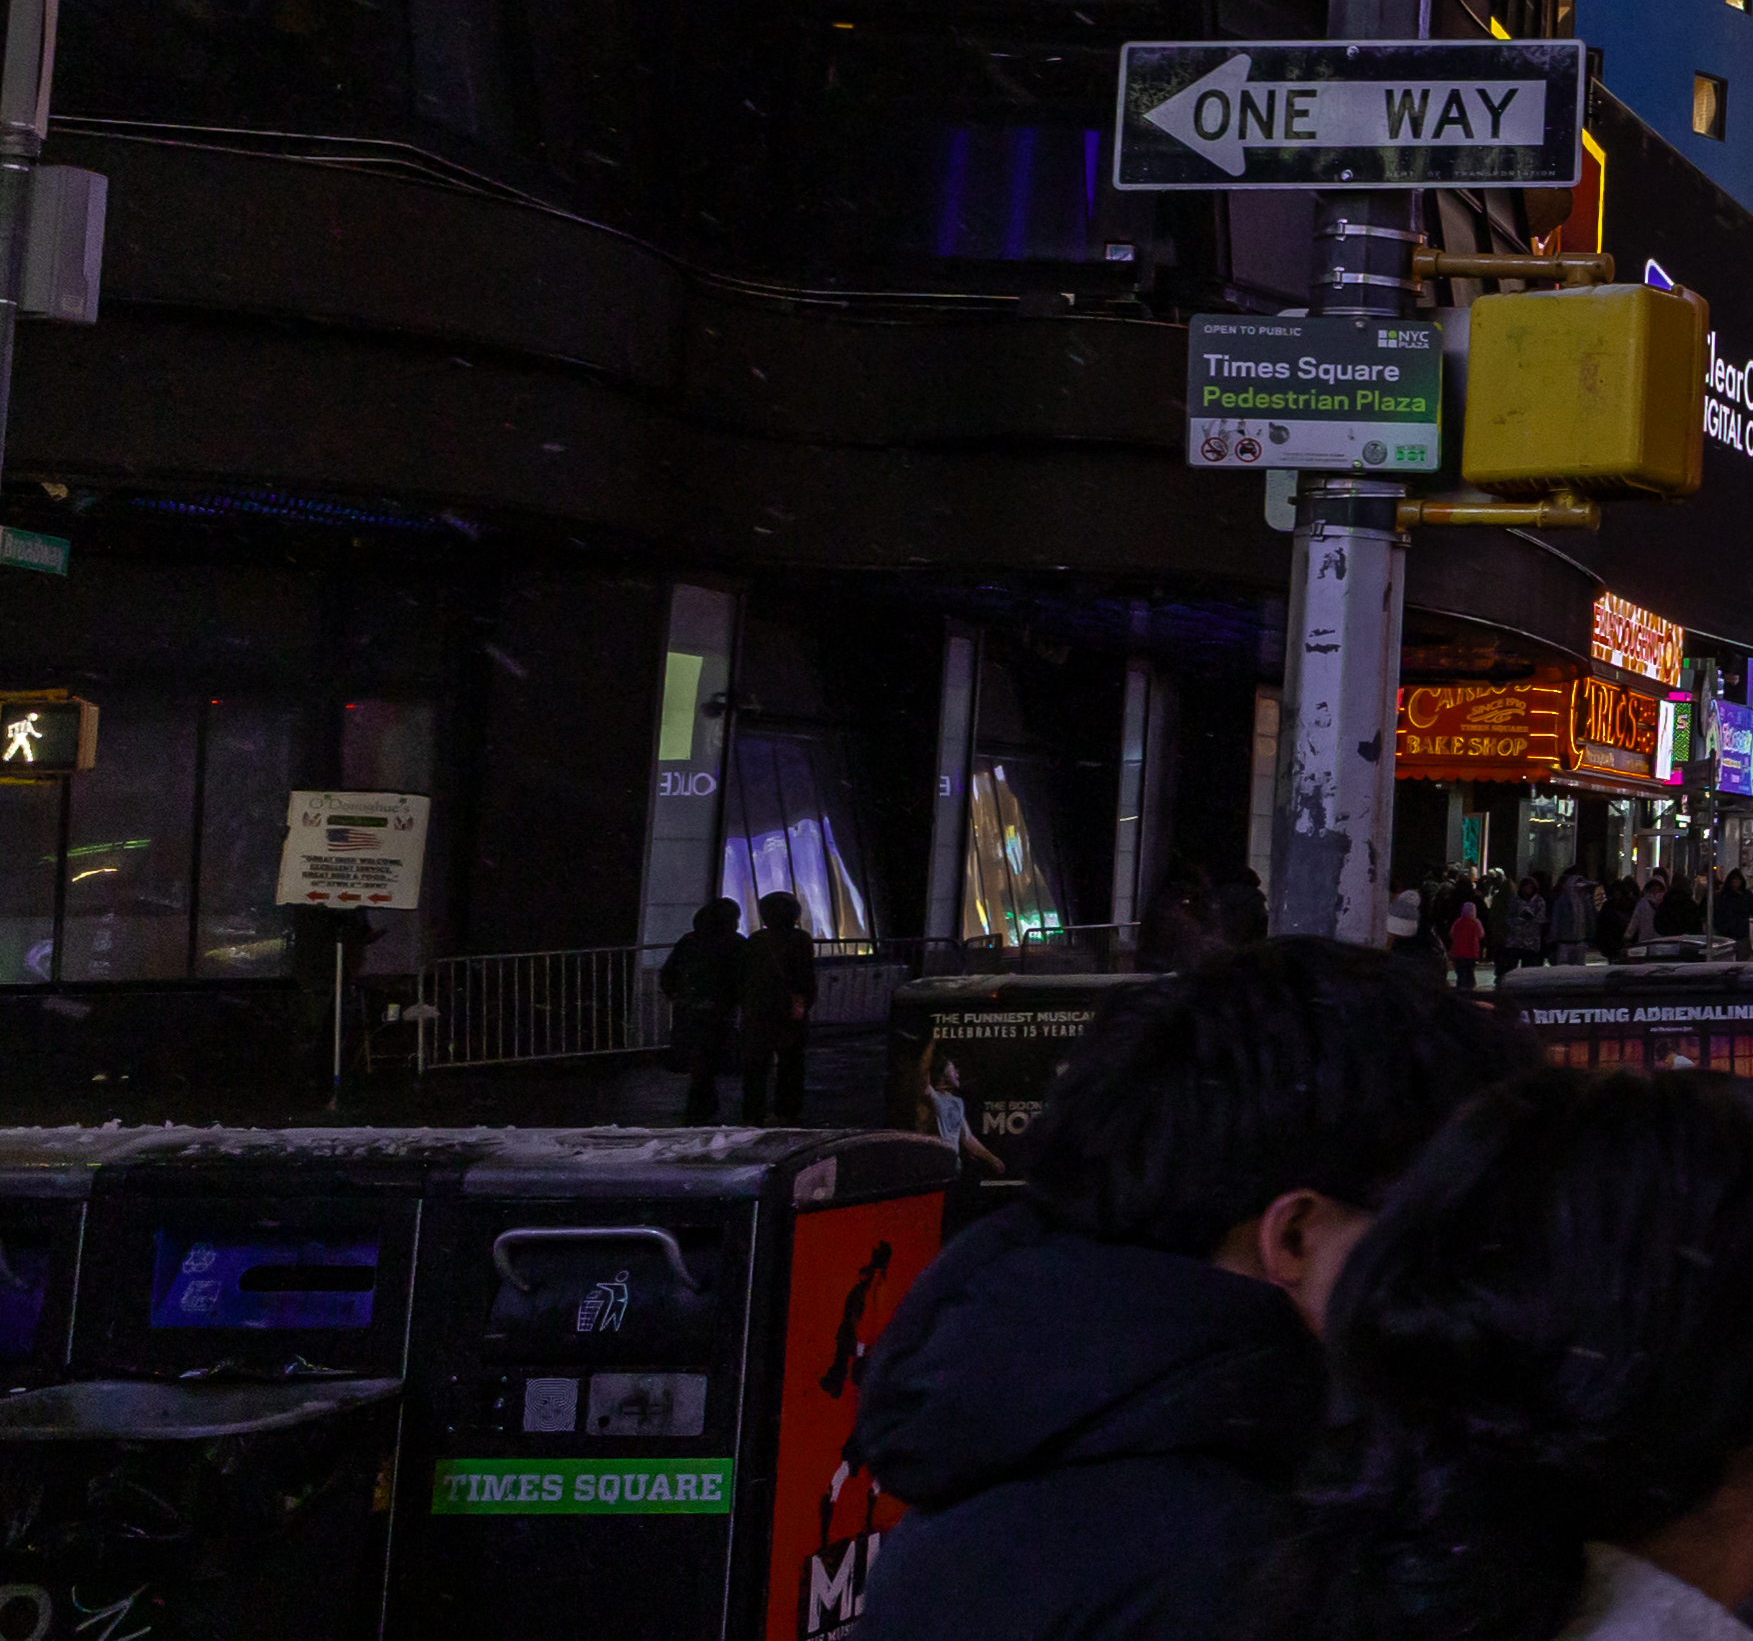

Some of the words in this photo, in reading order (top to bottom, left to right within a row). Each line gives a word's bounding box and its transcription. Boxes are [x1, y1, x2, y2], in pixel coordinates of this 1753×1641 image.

[1193, 88, 1318, 141] ONE
[1385, 87, 1519, 140] WAY
[1204, 325, 1236, 335] OPEN
[1240, 325, 1256, 335] TO
[1259, 326, 1302, 337] PUBLIC
[1398, 331, 1430, 342] NYC
[1203, 353, 1290, 378] Times
[1298, 357, 1400, 385] Square
[1203, 386, 1349, 410] Pedestrian
[1357, 390, 1427, 412] Plaza
[1703, 395, 1743, 451] IGITAL
[1471, 699, 1504, 714] SINCE
[963, 1012, 1034, 1024] FUNNIEST
[1533, 1008, 1630, 1025] RIVETING
[933, 1025, 1017, 1039] CELEBRATES
[1023, 1025, 1037, 1038] 15
[1043, 1024, 1085, 1038] YEARS
[443, 1472, 564, 1504] TIMES
[573, 1472, 724, 1504] SQUARE
